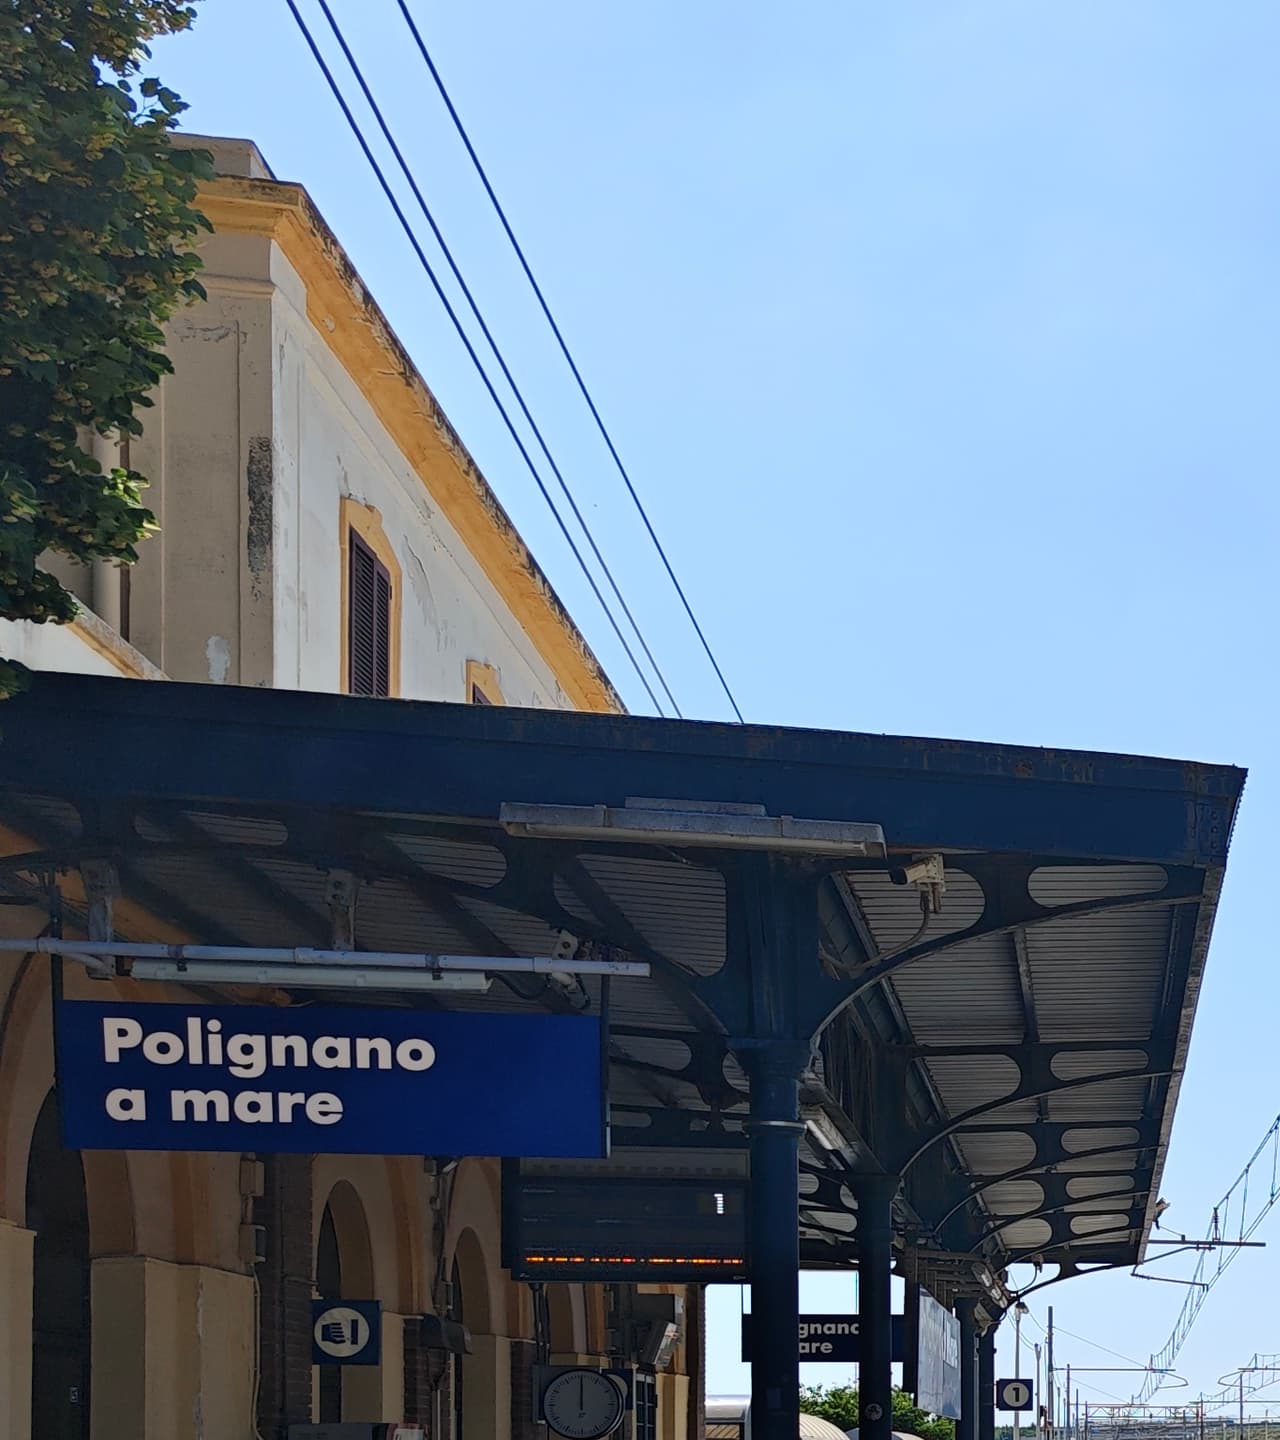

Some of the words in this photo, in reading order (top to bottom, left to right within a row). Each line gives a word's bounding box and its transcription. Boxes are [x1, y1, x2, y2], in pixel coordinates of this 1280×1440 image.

[102, 1016, 436, 1079] Polignano
[104, 1087, 147, 1122] a
[170, 1089, 344, 1126] mare
[713, 1193, 724, 1215] 1
[1012, 1386, 1020, 1403] 1
